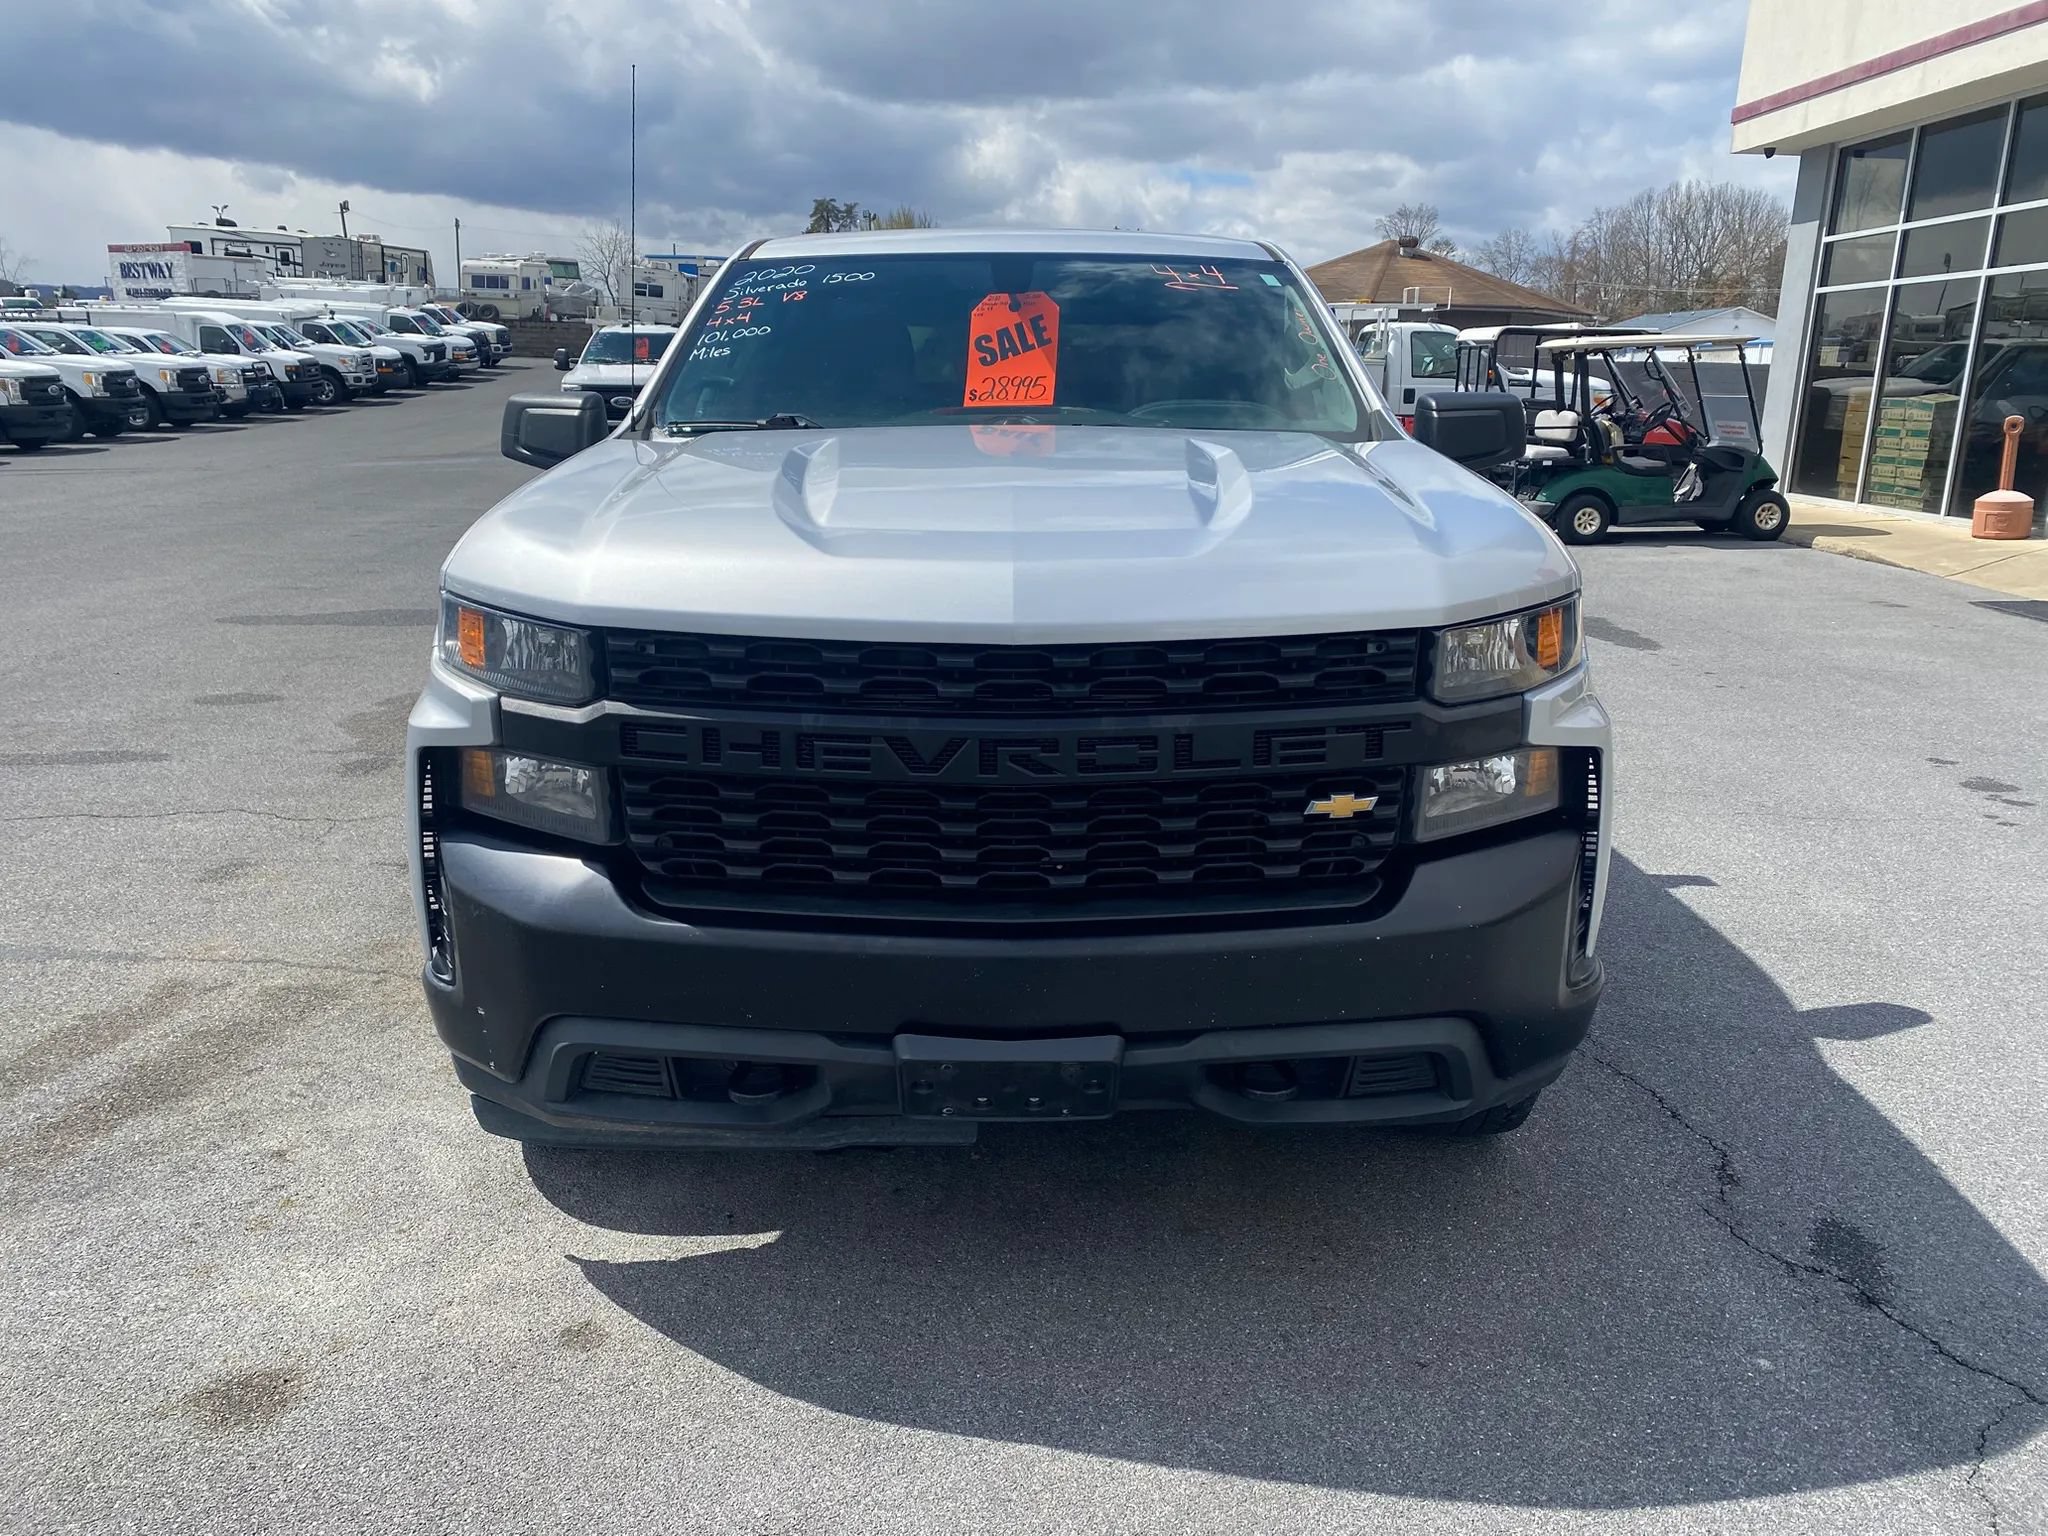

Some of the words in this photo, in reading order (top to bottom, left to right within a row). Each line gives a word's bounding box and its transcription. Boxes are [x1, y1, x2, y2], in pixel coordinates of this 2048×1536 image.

[119, 262, 173, 279] BESTWAY
[734, 264, 816, 286] 2020
[723, 279, 808, 300] Silverado
[822, 272, 876, 284] 1500
[783, 290, 808, 302] V8
[706, 312, 752, 327] 4x4
[974, 314, 1053, 367] SALE
[689, 346, 732, 360] Miles
[620, 719, 1413, 777] CHEVROLET
